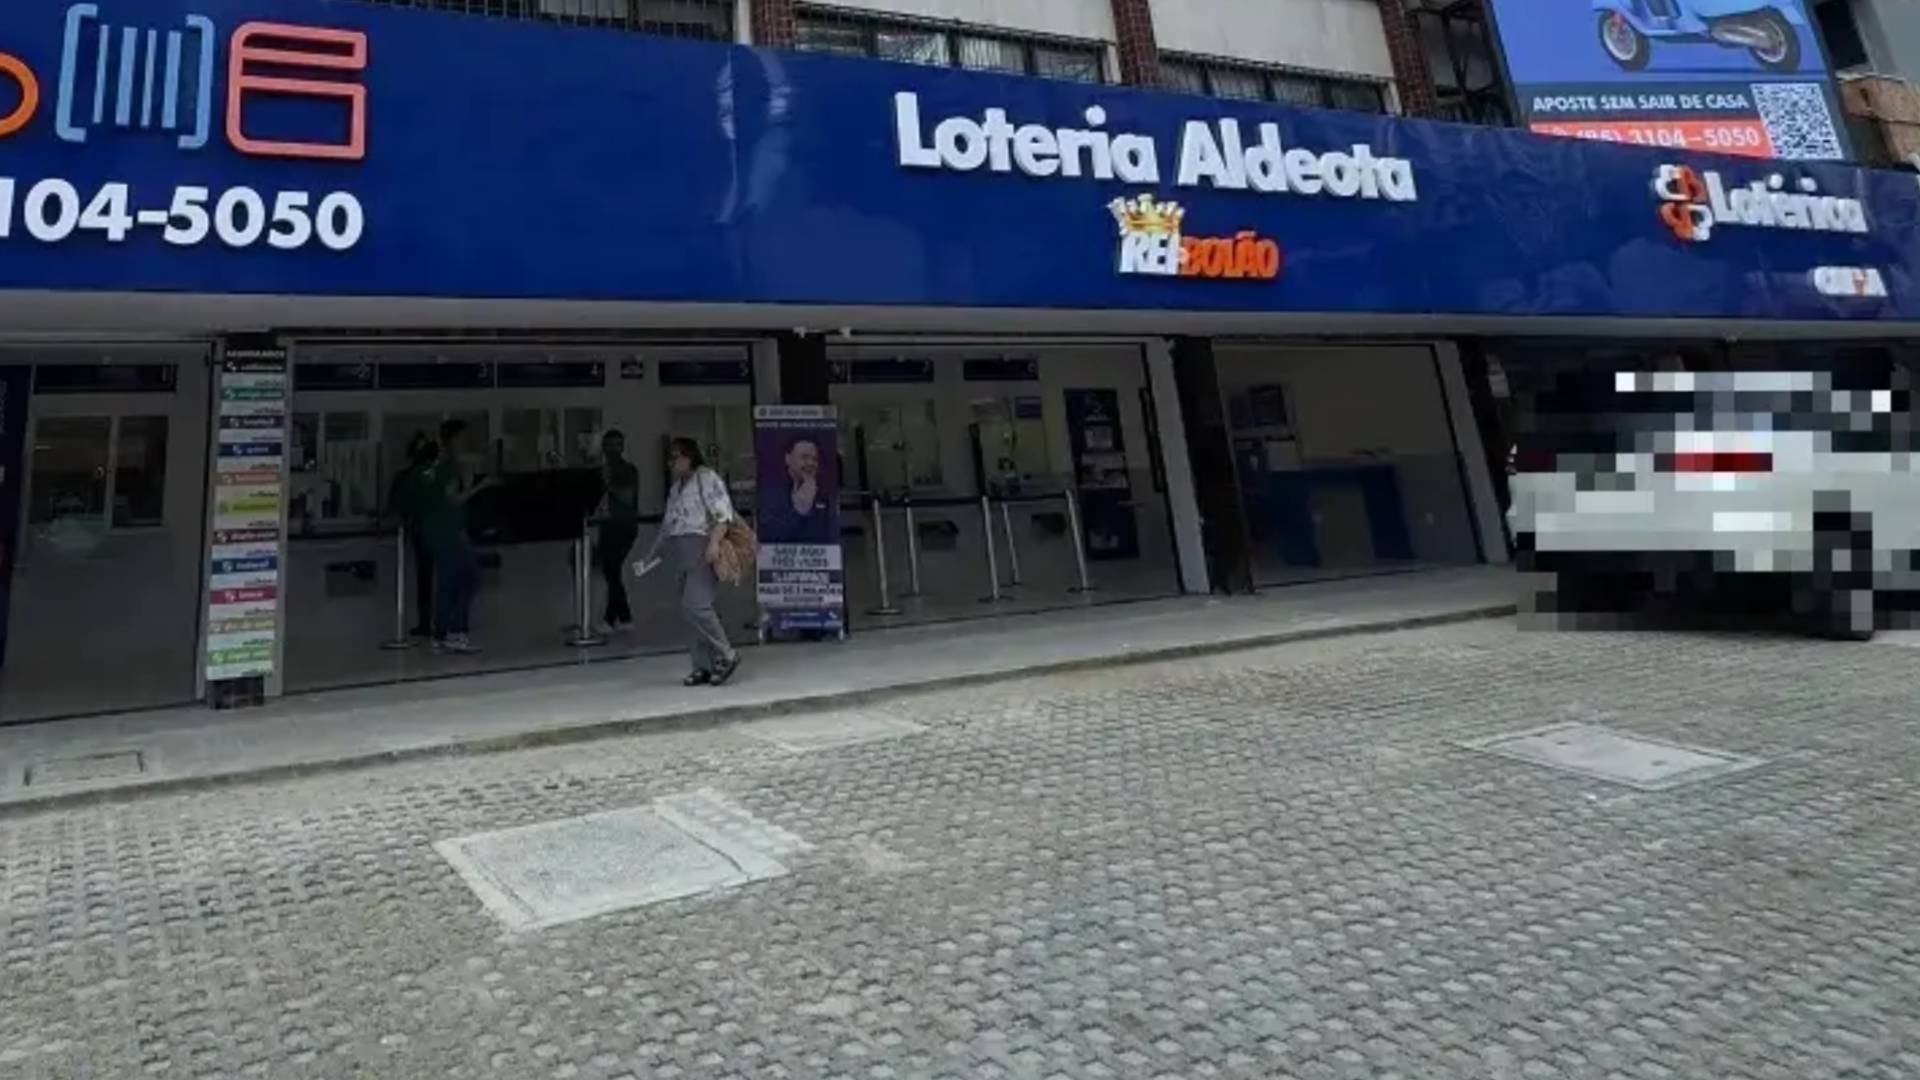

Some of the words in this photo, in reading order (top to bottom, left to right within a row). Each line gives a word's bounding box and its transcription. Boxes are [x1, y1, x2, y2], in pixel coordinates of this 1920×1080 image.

[1532, 96, 1597, 112] APOSTE
[1601, 96, 1637, 110] SEM
[1639, 95, 1678, 110] SAIR
[1680, 95, 1703, 109] DE
[1706, 94, 1751, 109] CASA
[895, 92, 1160, 186] Loteria
[1177, 117, 1418, 202] Aldeota
